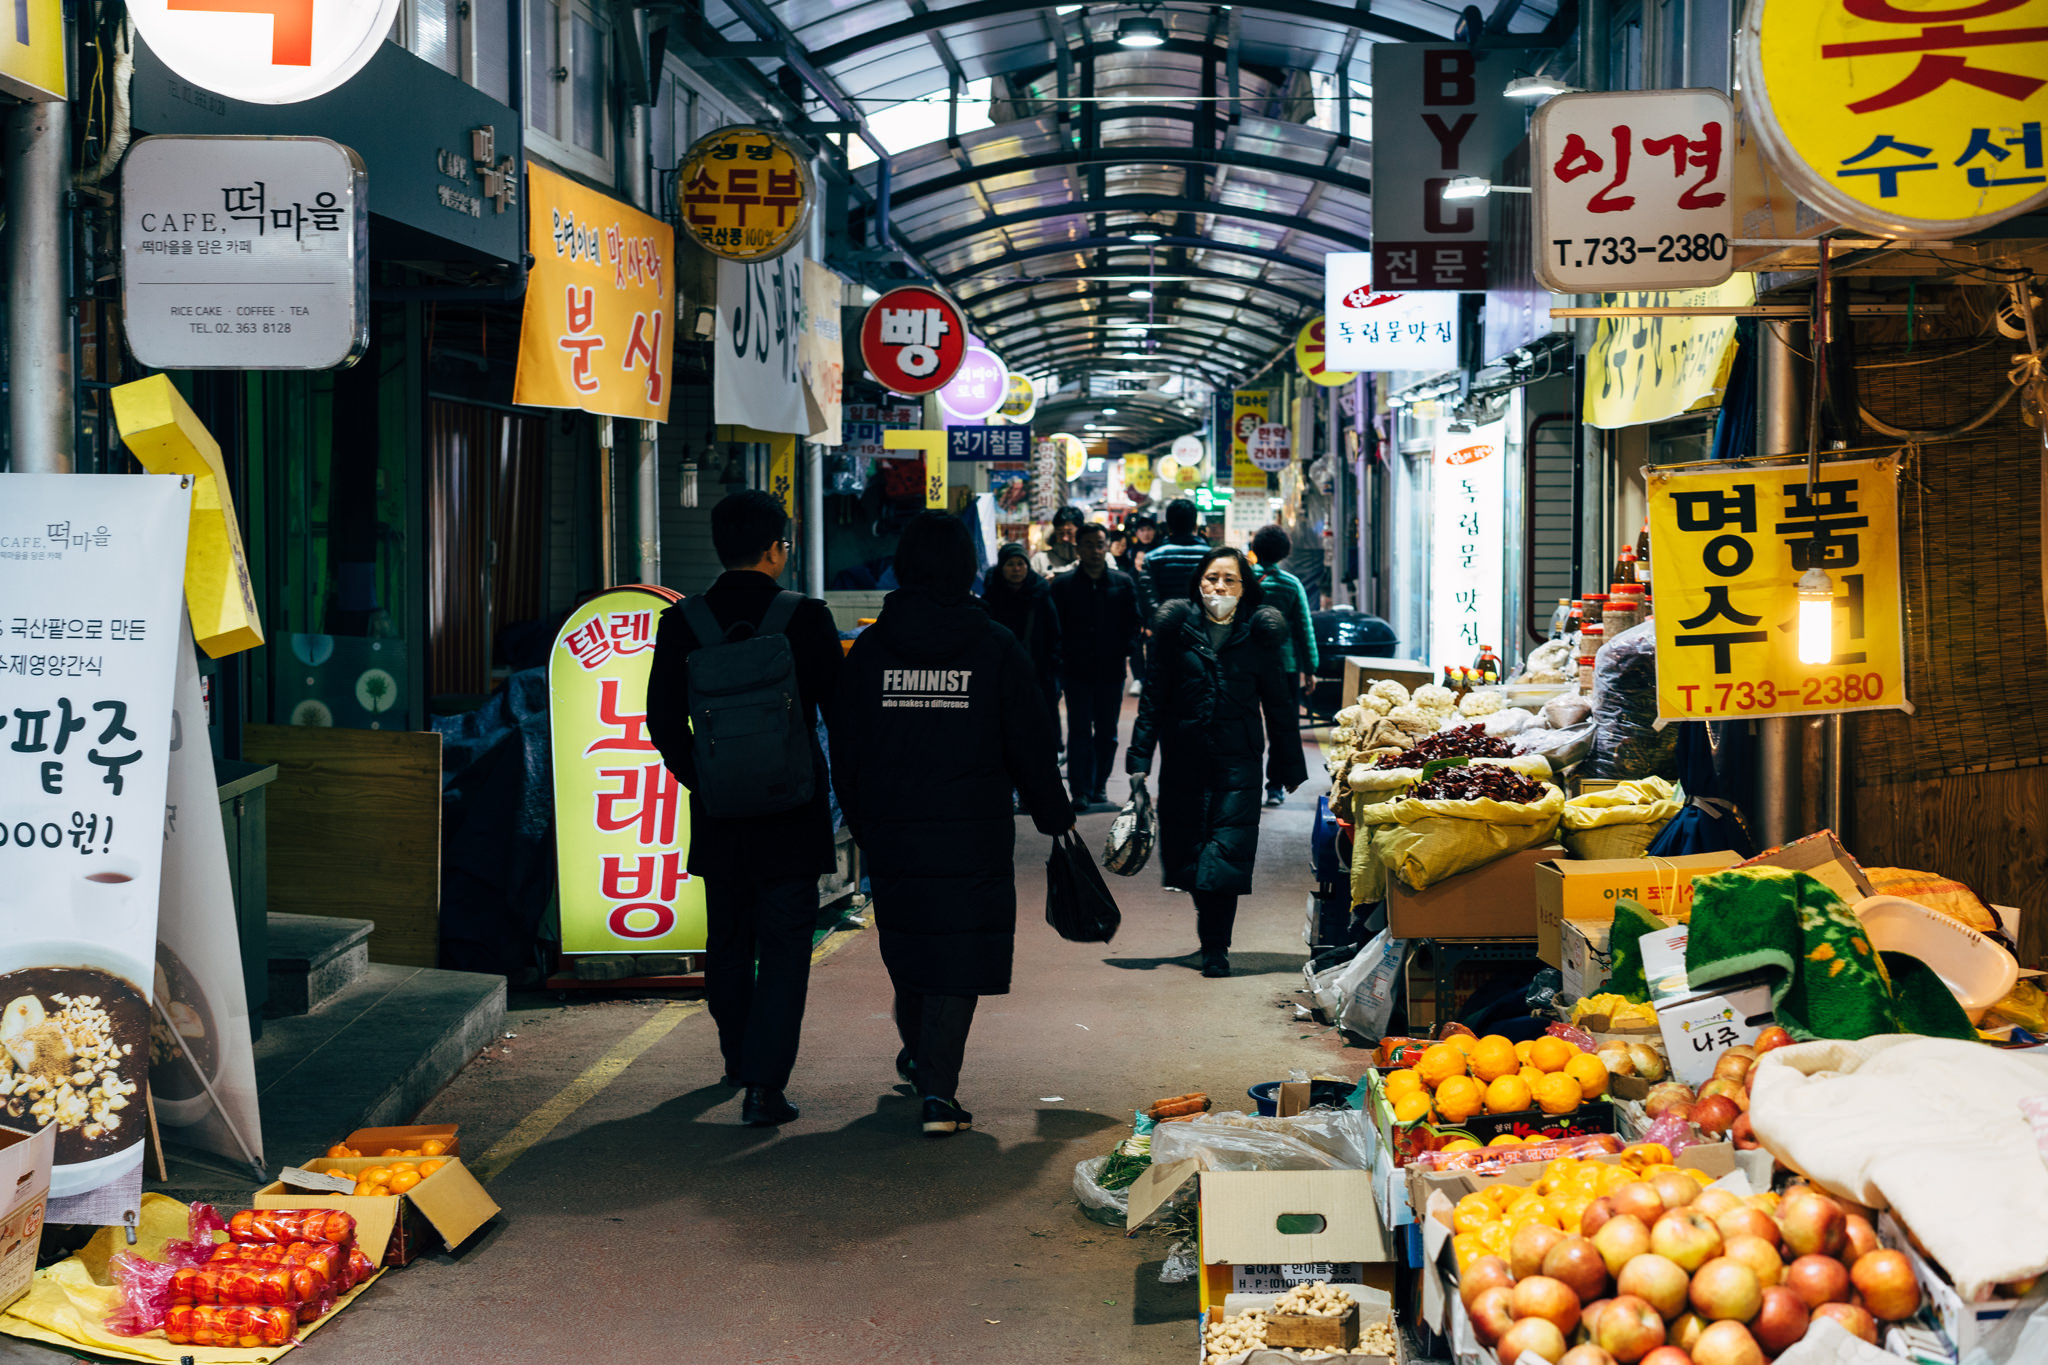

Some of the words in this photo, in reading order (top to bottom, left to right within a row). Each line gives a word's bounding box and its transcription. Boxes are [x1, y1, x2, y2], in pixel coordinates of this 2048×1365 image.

[1421, 50, 1478, 233] BYC
[1554, 121, 1726, 213] 인견
[1836, 122, 2047, 198] 수선
[141, 213, 226, 234] CAFE,
[221, 181, 345, 242] 떡마을
[684, 167, 801, 227] 손두부
[142, 240, 193, 254] 떡마을을
[197, 240, 223, 254] 담은
[226, 240, 252, 253] 카페
[1553, 232, 1728, 268] T.733-2380
[1384, 249, 1488, 285] 전문
[171, 306, 193, 316] RICE
[195, 306, 223, 316] CAKE
[236, 306, 276, 316] COFFEE
[290, 306, 309, 316] TEA
[236, 322, 257, 334] 363
[262, 322, 292, 334] 8128
[558, 286, 663, 404] 분식
[879, 307, 949, 377] 빵
[951, 366, 1000, 383] 리비아
[952, 430, 1025, 456] 전기철물
[47, 520, 112, 552] 떡마을
[1669, 478, 1869, 578] 명품
[11, 618, 103, 639] 국산팥으로
[110, 619, 146, 640] 만든
[883, 669, 973, 692] FEMINIST
[1677, 671, 1884, 713] T.733-2380
[882, 699, 898, 707] who
[899, 699, 924, 708] makes
[931, 699, 969, 709] difference
[0, 697, 143, 796] 팥죽
[585, 680, 689, 938] 노래방
[1692, 1026, 1740, 1052] 나주
